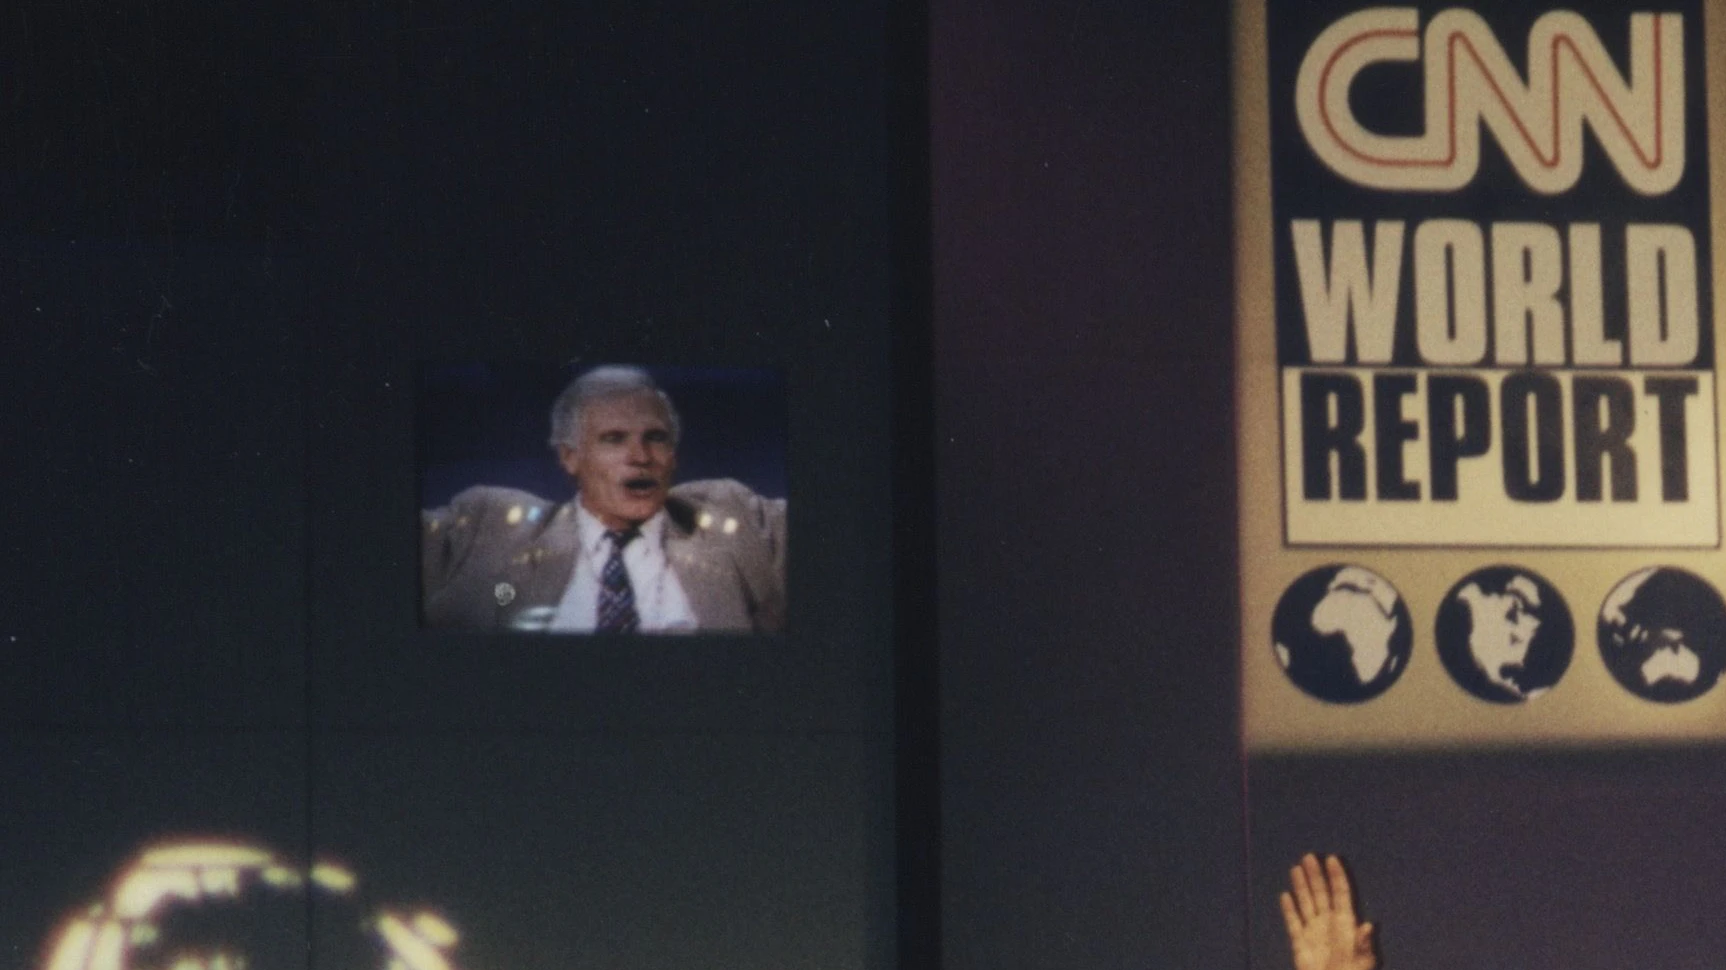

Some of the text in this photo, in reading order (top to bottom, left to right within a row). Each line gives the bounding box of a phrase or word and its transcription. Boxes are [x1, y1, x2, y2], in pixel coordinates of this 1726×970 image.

[1296, 7, 1686, 194] CNN
[1292, 218, 1698, 365] WORLD
[1301, 372, 1699, 502] REPORT
